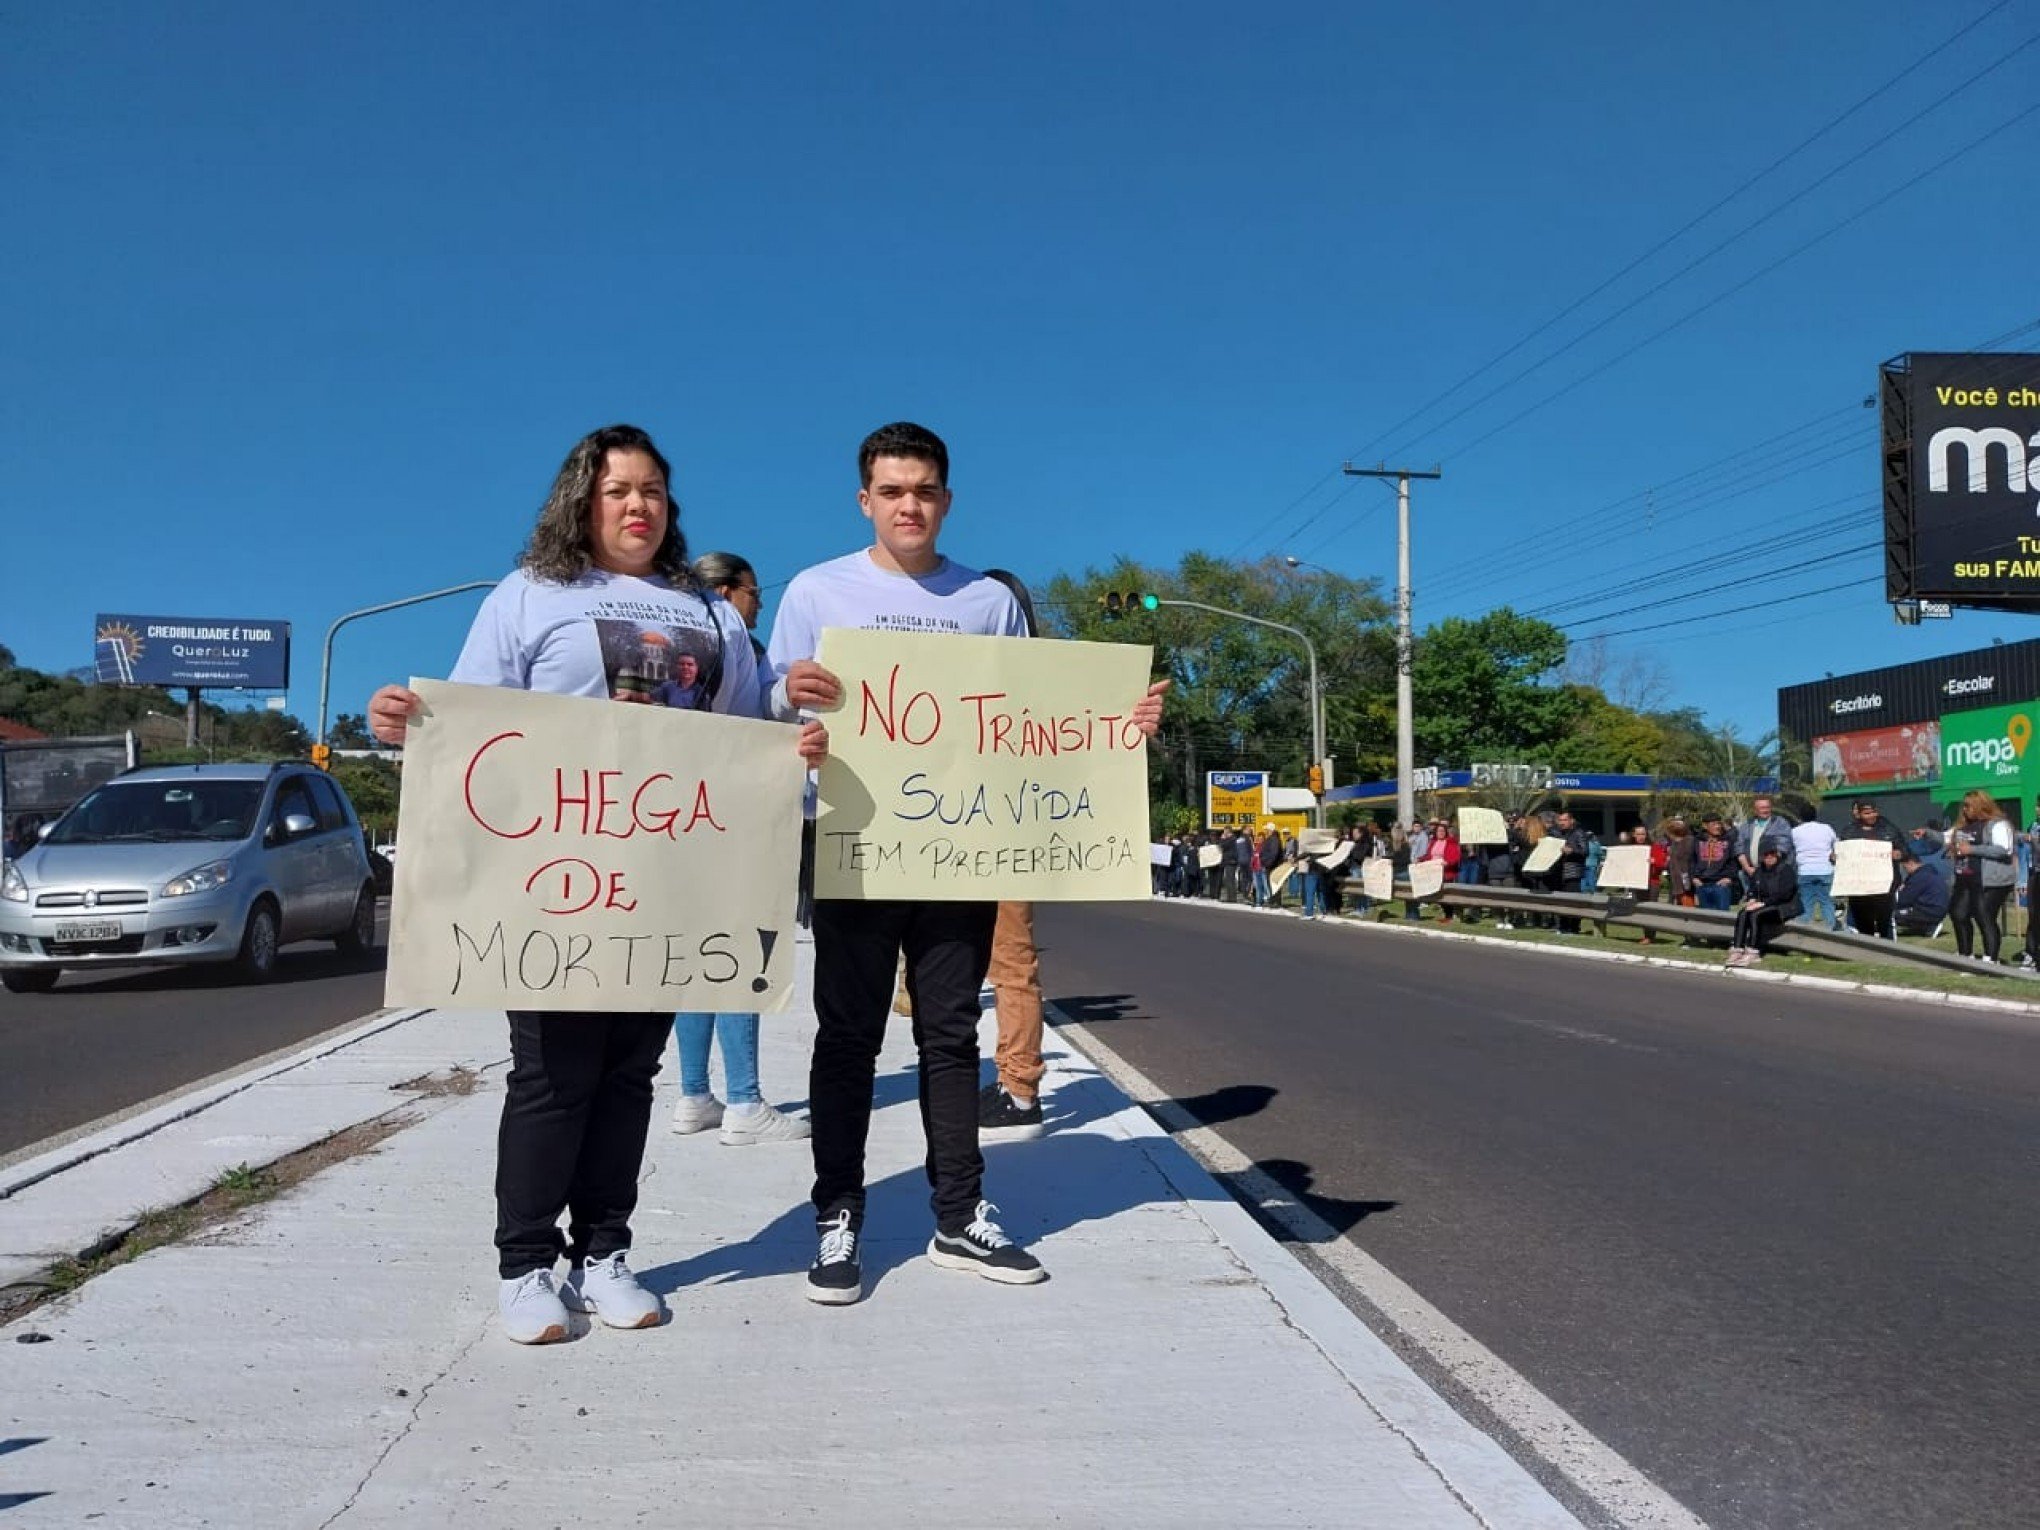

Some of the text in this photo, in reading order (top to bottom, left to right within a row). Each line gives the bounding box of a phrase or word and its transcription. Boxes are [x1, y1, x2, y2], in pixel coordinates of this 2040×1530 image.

[1936, 386, 1998, 407] Você
[1954, 562, 1990, 578] sua
[147, 625, 230, 640] CREDIBILIDADE
[232, 626, 240, 641] É
[860, 663, 941, 746] NO
[1947, 736, 2016, 771] mapa
[464, 732, 726, 841] CHEGA
[893, 773, 993, 826] SUA
[825, 831, 906, 875] TEM
[525, 857, 638, 915] DE
[451, 920, 778, 995] MORTES!
